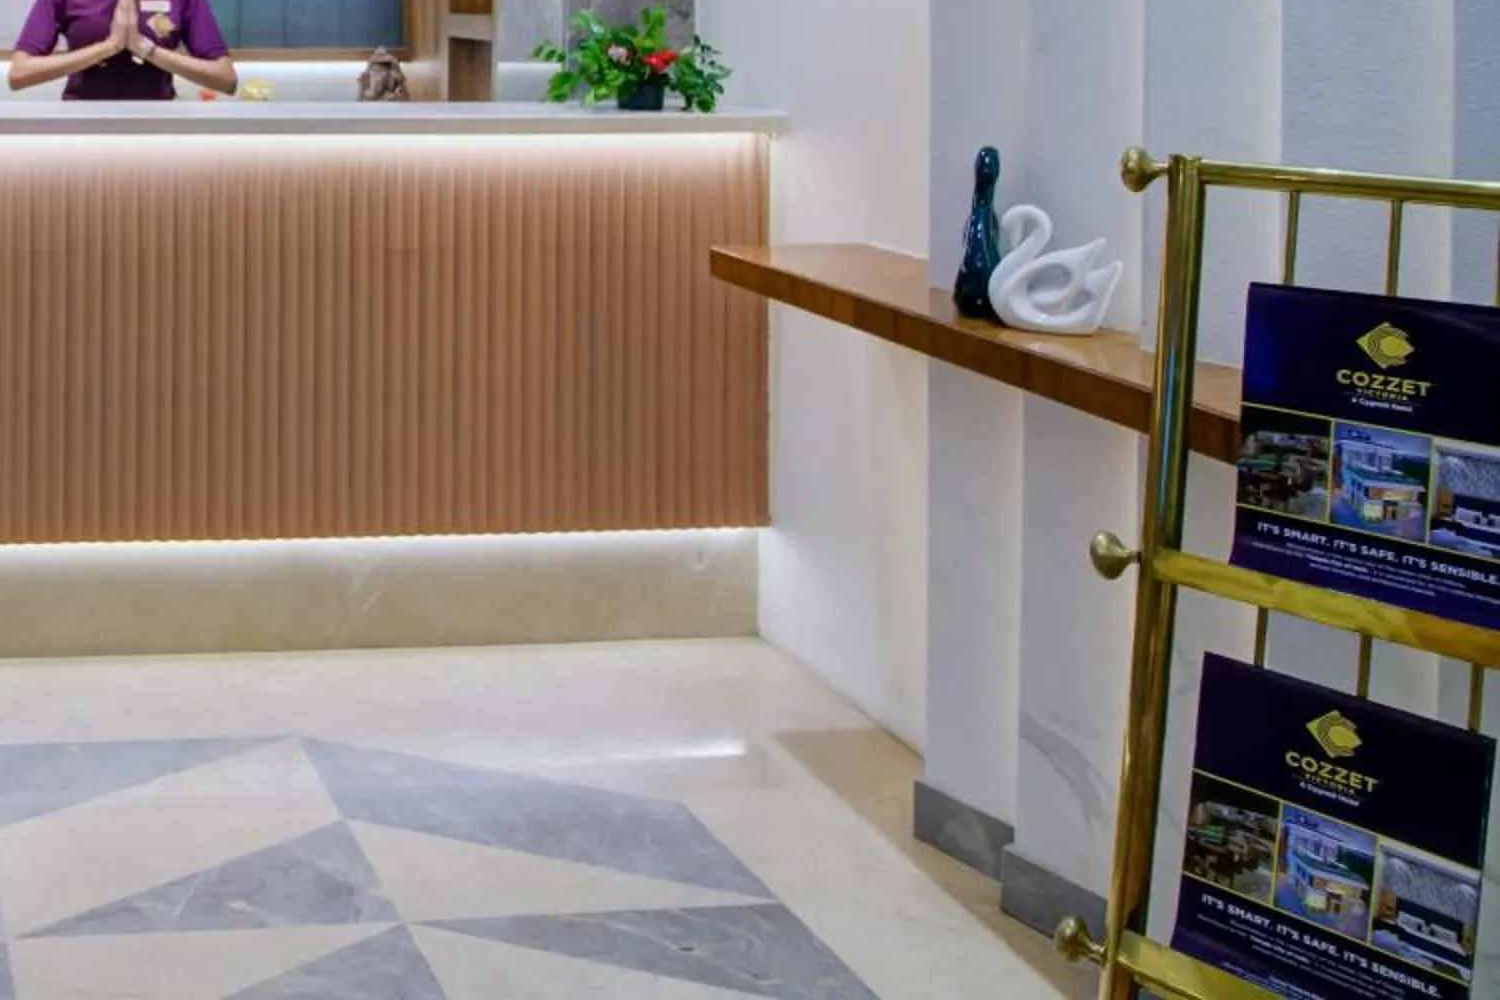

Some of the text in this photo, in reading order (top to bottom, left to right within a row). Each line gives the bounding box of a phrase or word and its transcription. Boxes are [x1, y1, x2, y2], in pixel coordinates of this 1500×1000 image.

[1336, 369, 1431, 396] COZZET
[1257, 521, 1280, 535] IT'S
[1283, 527, 1330, 546] SMART.
[1333, 539, 1357, 553] IT'S
[1361, 545, 1399, 563] SAFE.
[1402, 555, 1427, 569] IT'S
[1285, 751, 1379, 793] COZZET
[1201, 893, 1442, 999] IT'S SMART. IT'S SAFE. IT'S SENSIBLE.
